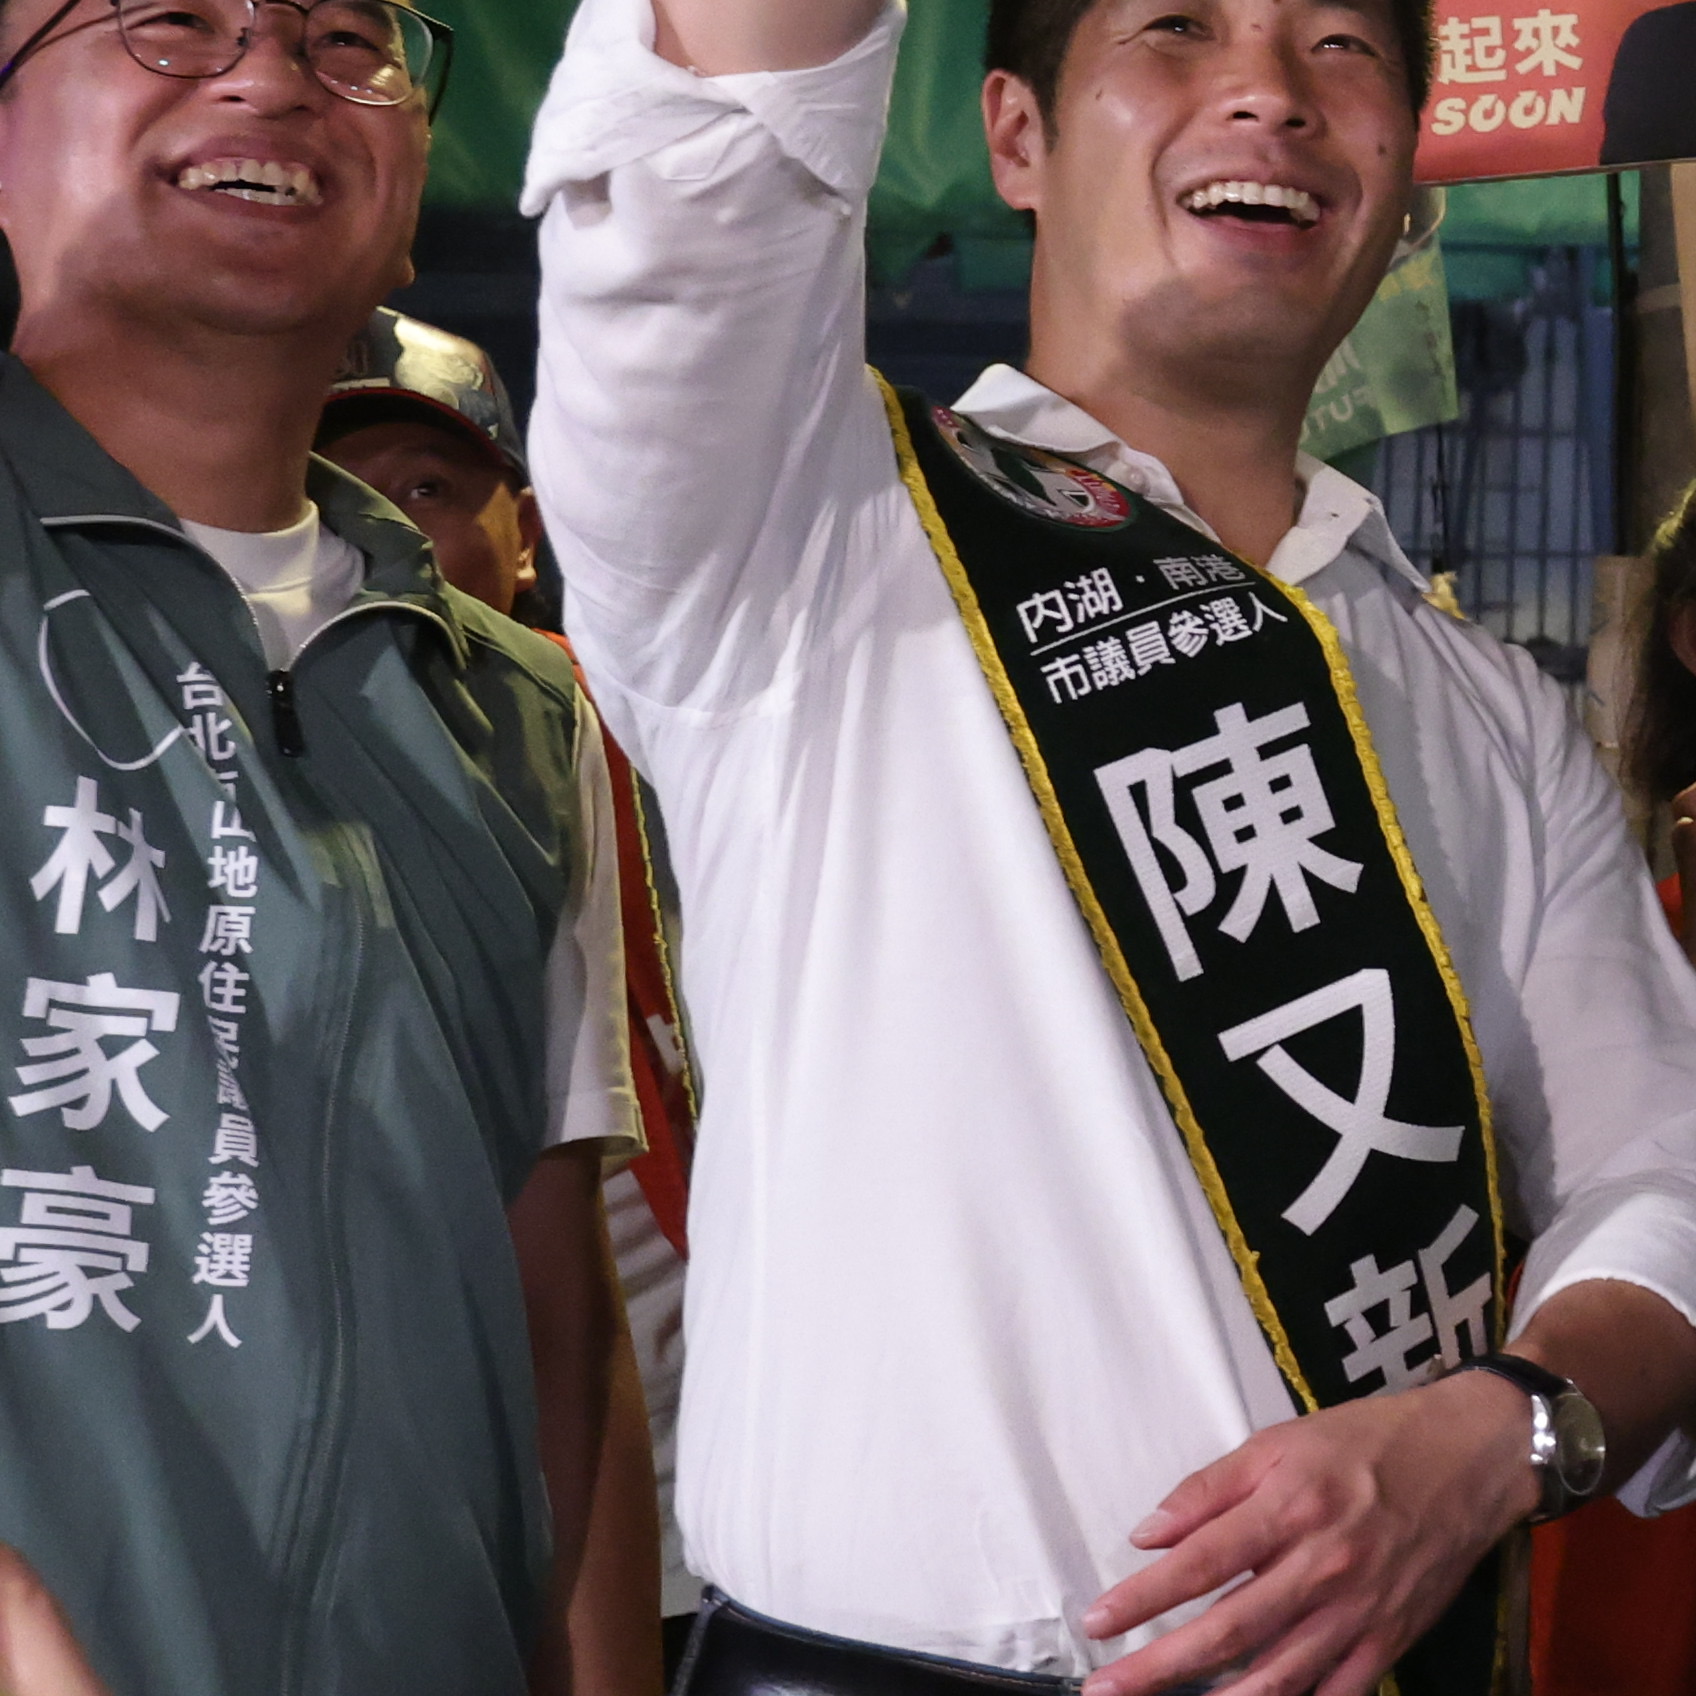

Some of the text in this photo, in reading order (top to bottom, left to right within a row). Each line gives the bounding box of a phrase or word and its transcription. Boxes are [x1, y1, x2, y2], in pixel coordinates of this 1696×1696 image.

[1436, 8, 1583, 85] 起來
[1431, 86, 1586, 135] SOON
[1040, 590, 1288, 704] 市議員參選人
[0, 775, 181, 1331] 林家豪
[1093, 700, 1492, 1396] 陳又新
